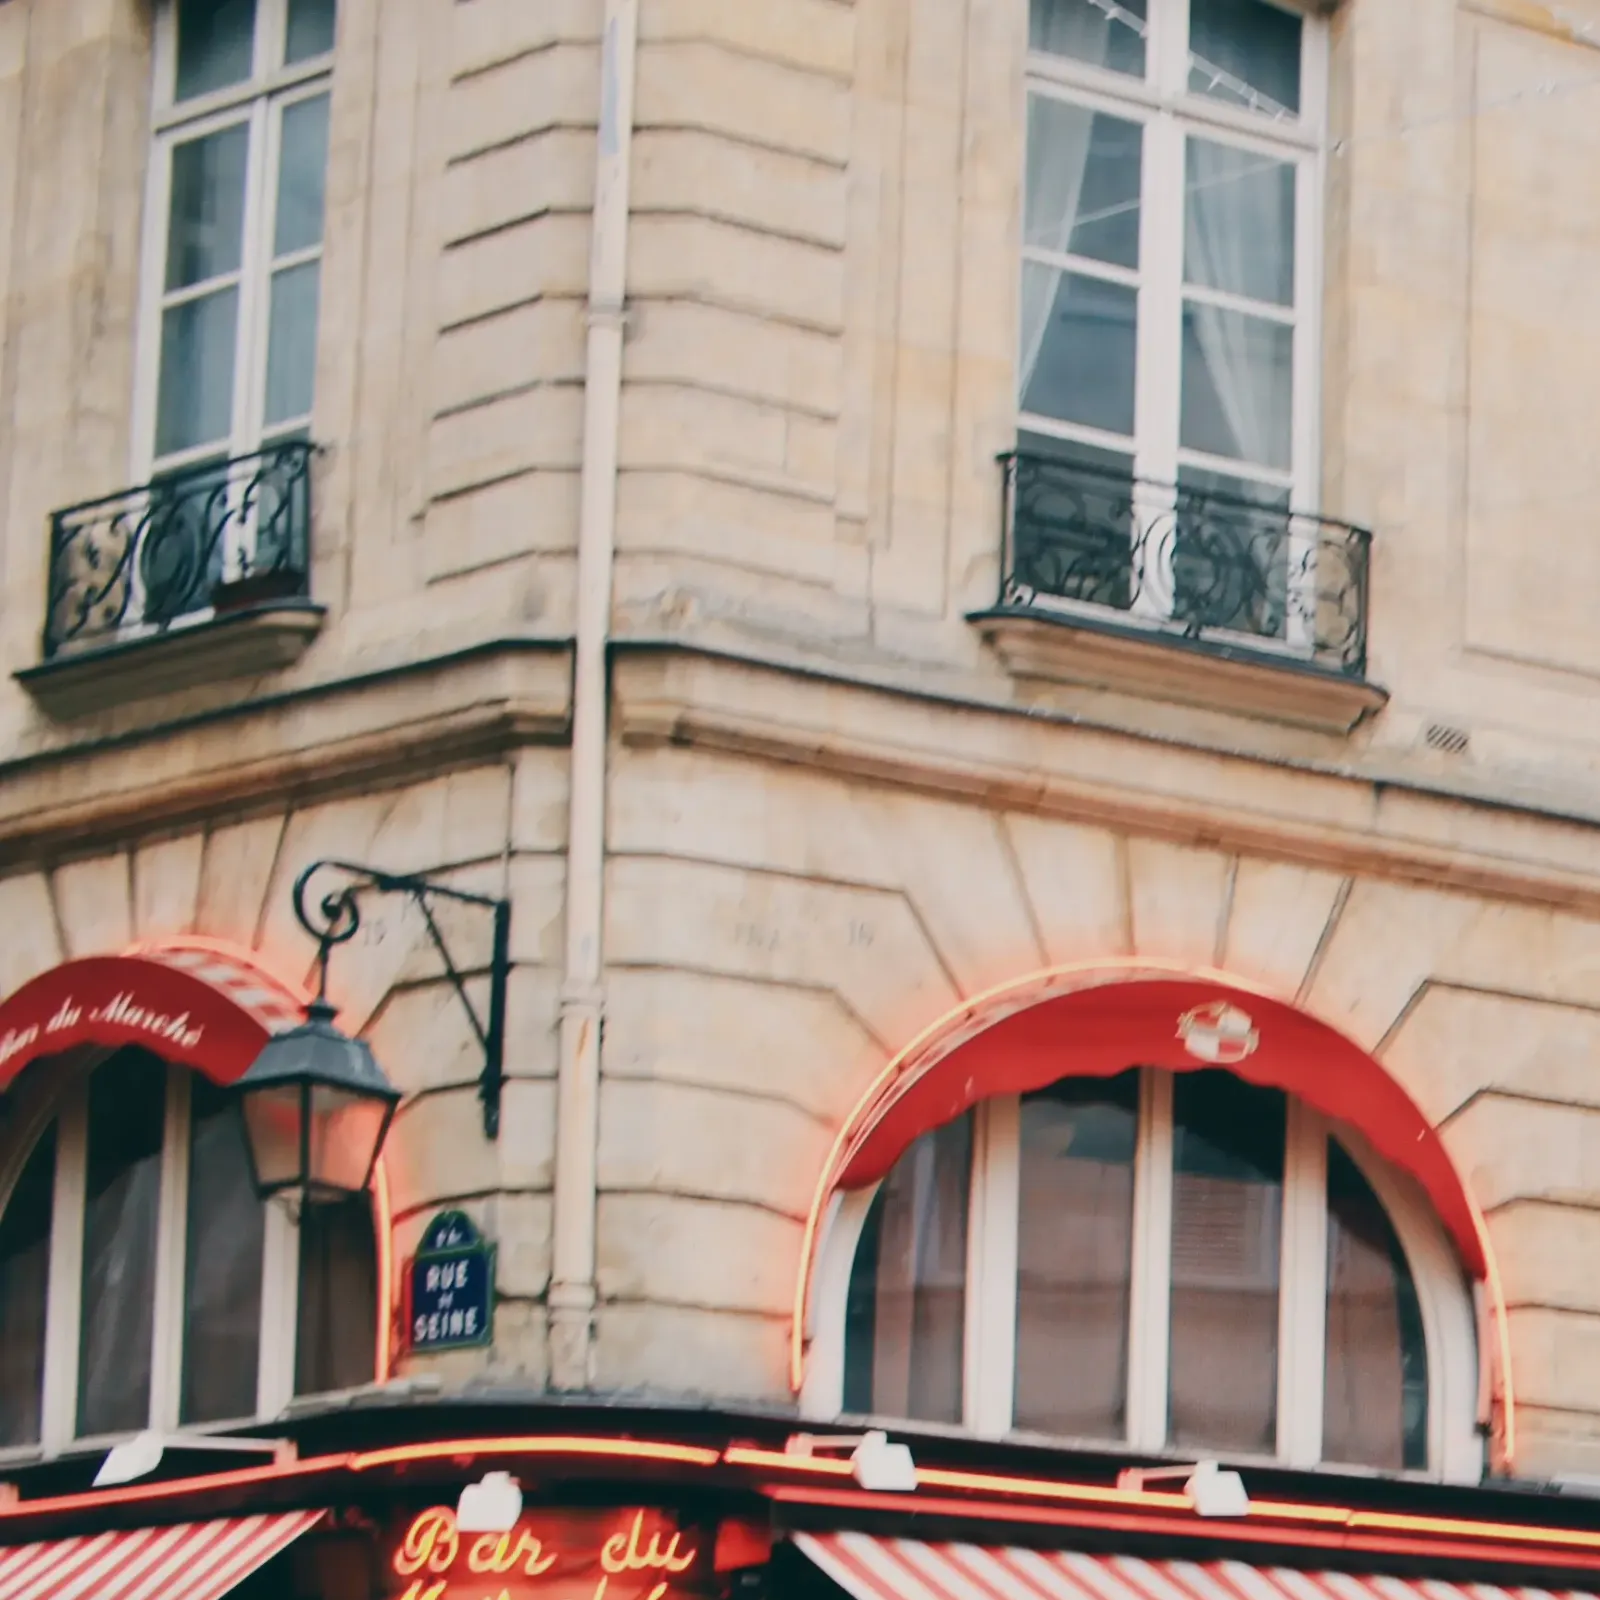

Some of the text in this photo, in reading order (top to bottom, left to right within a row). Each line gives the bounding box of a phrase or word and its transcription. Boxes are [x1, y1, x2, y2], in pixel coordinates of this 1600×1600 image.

[46, 995, 83, 1034] du
[89, 991, 204, 1048] Marché
[426, 1260, 469, 1292] RUE
[414, 1306, 478, 1342] SEINE
[393, 1505, 696, 1576] Bar du
